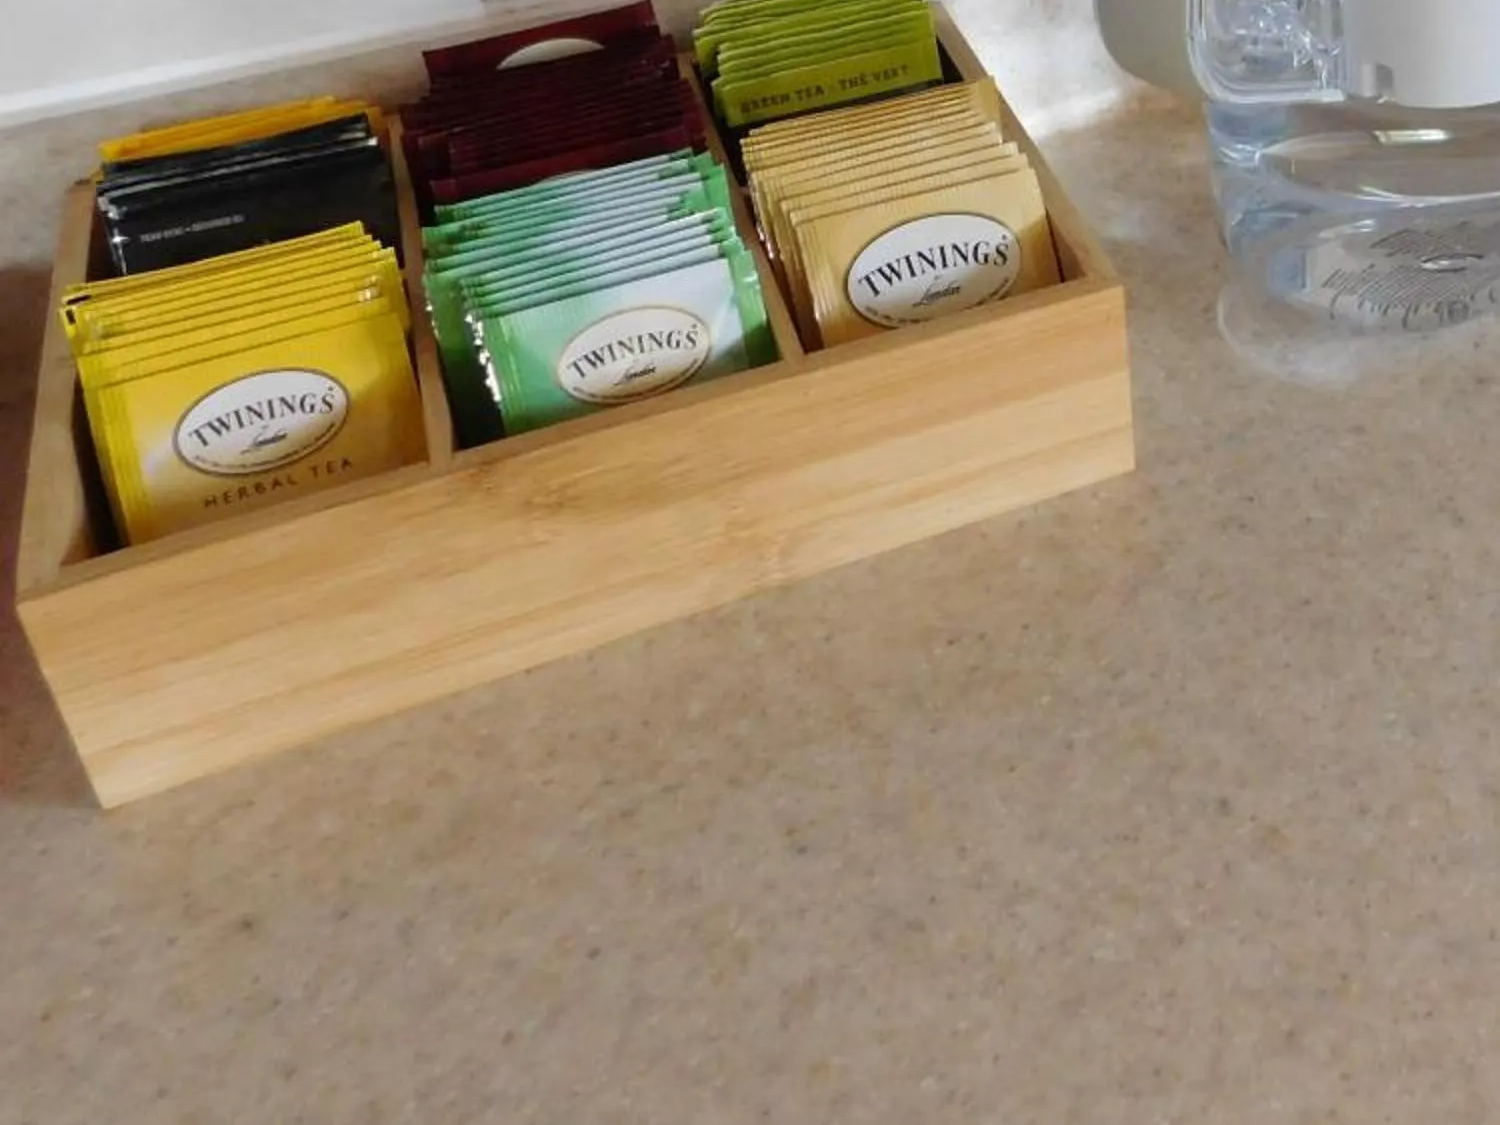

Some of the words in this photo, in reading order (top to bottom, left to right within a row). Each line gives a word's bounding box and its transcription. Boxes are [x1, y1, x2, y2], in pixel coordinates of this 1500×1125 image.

[794, 84, 825, 102] TEA
[857, 240, 1009, 298] TWININGS
[566, 330, 700, 379] TWININGS
[187, 392, 336, 448] TWININGS
[204, 475, 299, 508] HERBAL
[308, 458, 353, 479] TEA
